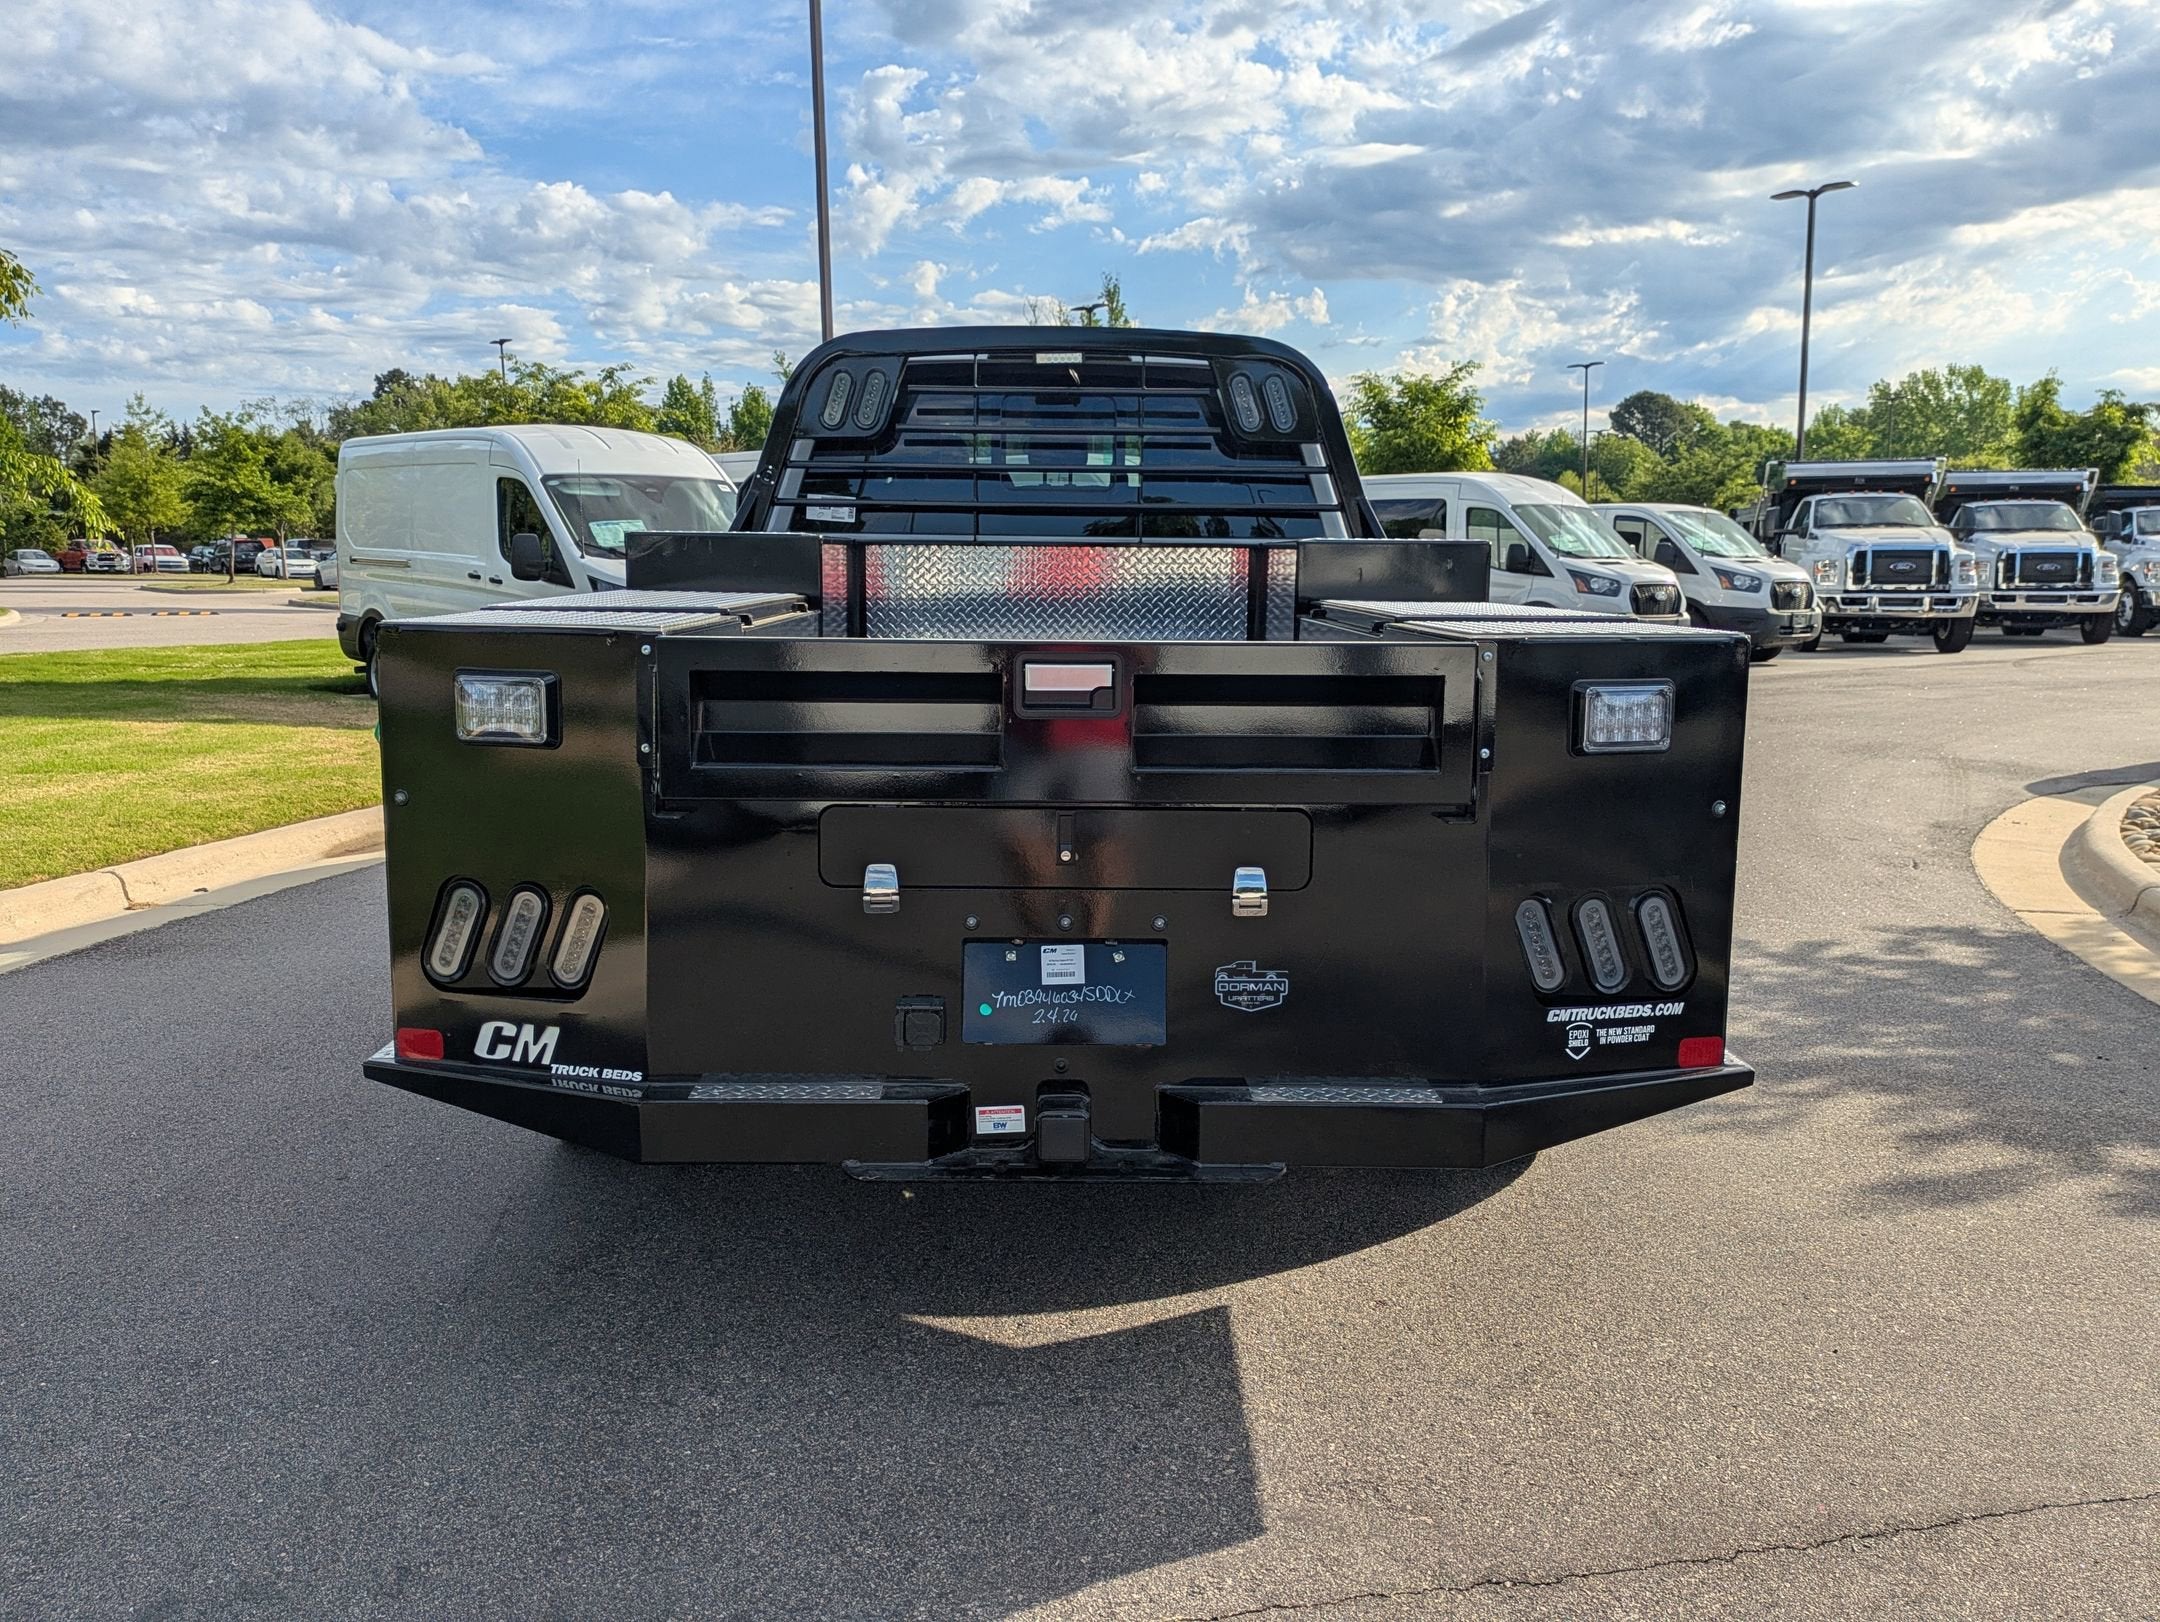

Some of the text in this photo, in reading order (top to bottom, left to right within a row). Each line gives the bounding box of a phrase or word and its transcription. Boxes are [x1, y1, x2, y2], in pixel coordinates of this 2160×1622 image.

[1218, 982, 1285, 992] DORMAN
[1547, 1002, 1685, 1022] CMTRUCKBEDS.COM
[1568, 1029, 1589, 1040] EPOXI
[1596, 1024, 1655, 1037] THE NEW STANDARD
[473, 1021, 561, 1065] CM
[1567, 1039, 1589, 1048] SHIELD
[1599, 1033, 1650, 1045] IN POWDER COAT
[550, 1063, 643, 1082] TRUCK BEDS
